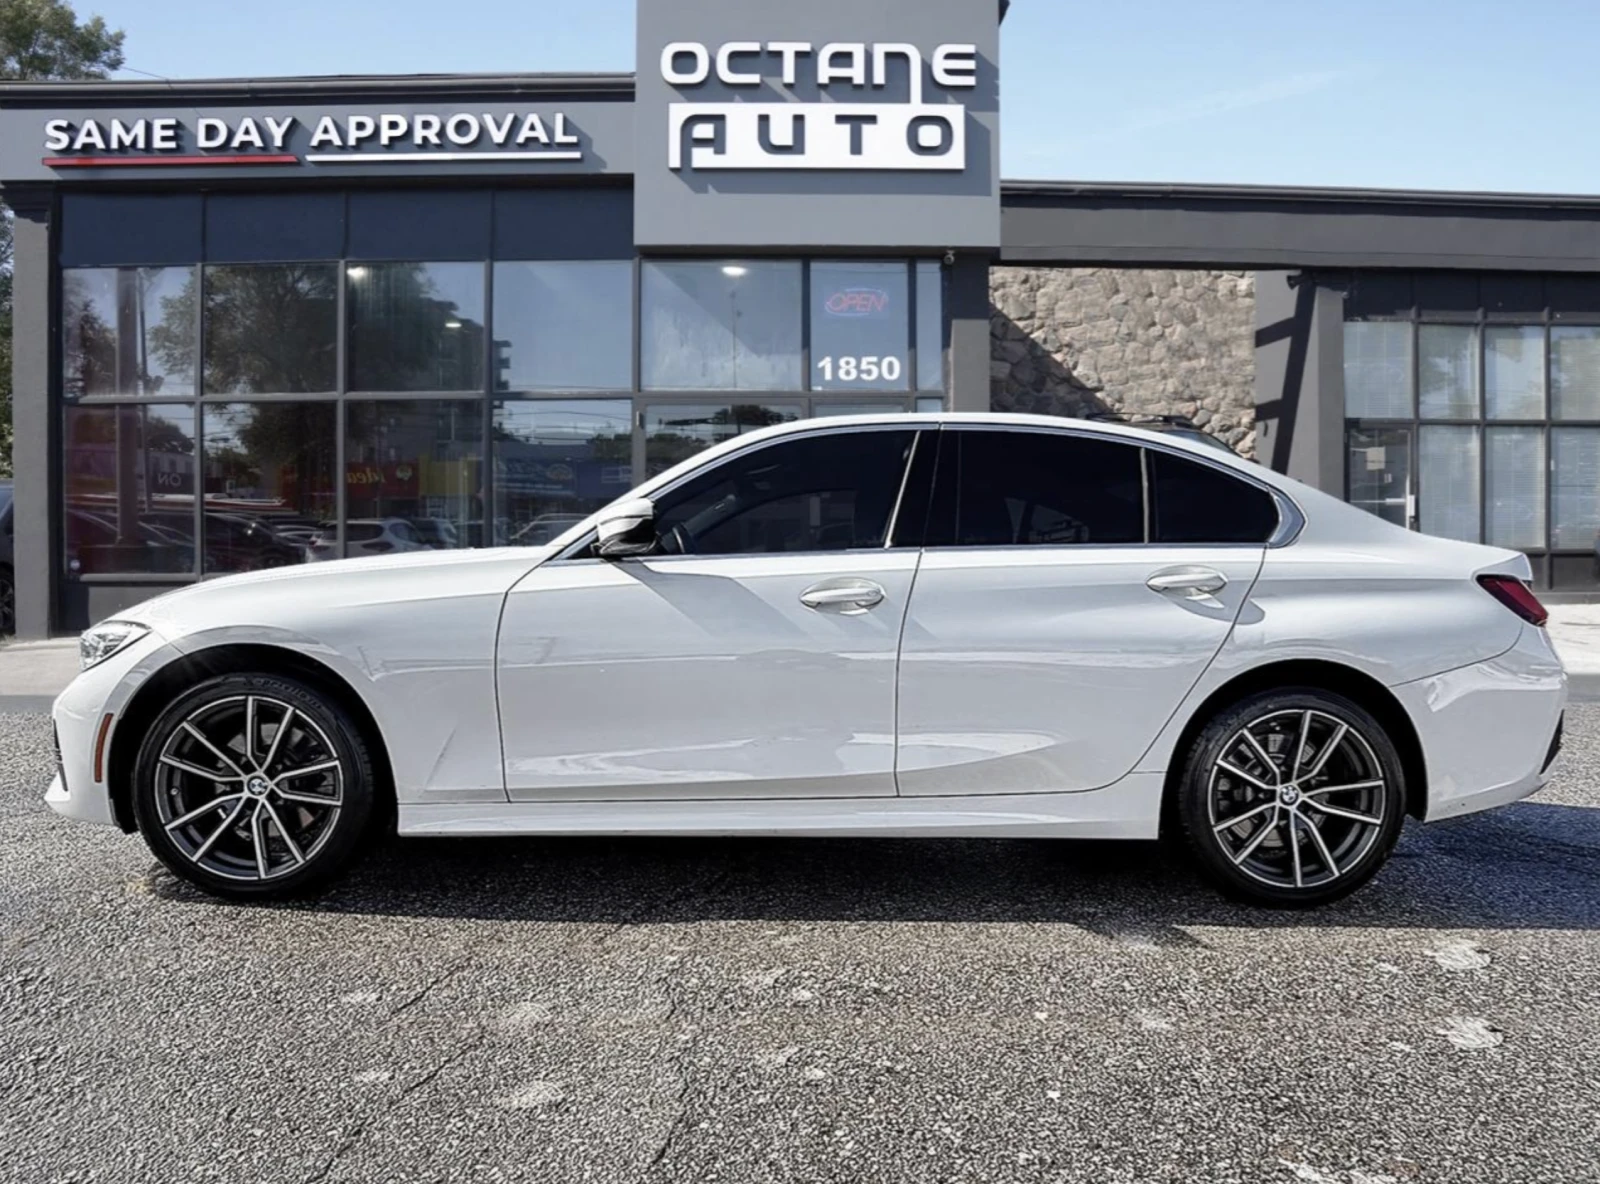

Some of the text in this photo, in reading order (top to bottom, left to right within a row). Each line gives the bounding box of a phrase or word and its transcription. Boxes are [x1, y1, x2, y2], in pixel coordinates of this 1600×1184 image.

[660, 42, 976, 103] OCTANE
[44, 113, 579, 151] SAME DAY APPROVAL
[676, 112, 957, 168] AUTO
[826, 292, 888, 312] OPEN
[817, 355, 901, 381] 1850
